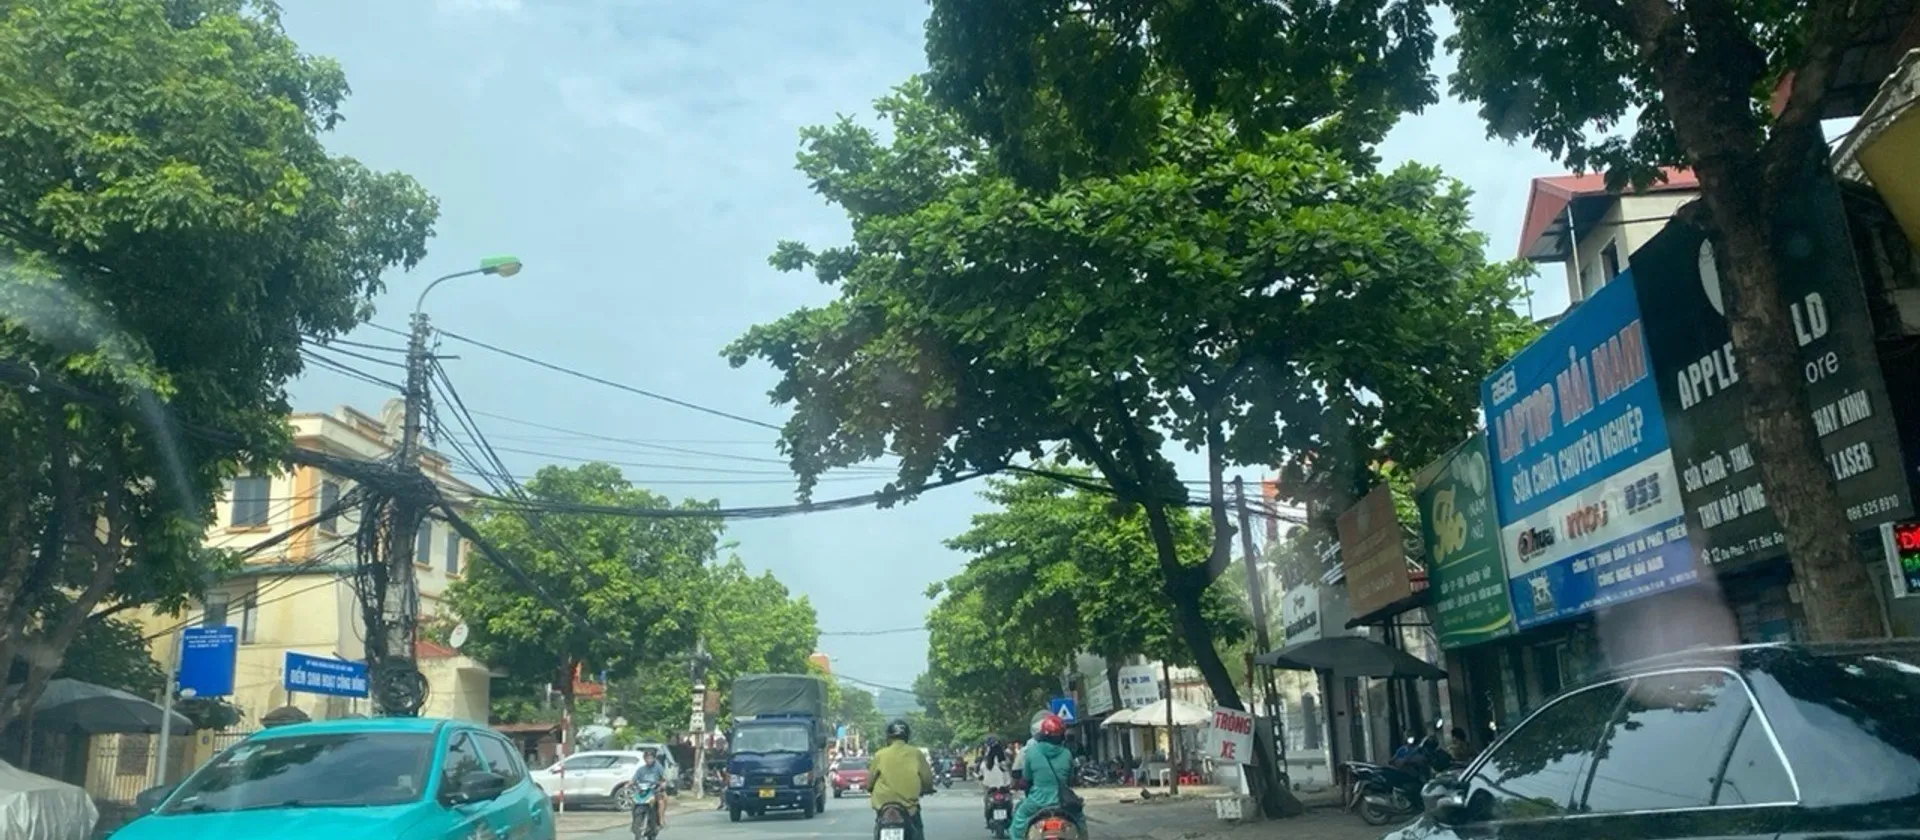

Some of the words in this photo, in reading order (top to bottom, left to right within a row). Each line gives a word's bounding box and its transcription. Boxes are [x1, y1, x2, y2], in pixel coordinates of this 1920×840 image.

[1496, 382, 1556, 464] LAPTOP
[1556, 345, 1594, 427] HẢI
[1591, 318, 1648, 405] NAM
[1676, 341, 1739, 410] APPLE
[1837, 388, 1872, 427] KÍNH
[1532, 453, 1560, 494] CHỮA
[1558, 429, 1601, 482] CHUYÊN
[1600, 403, 1644, 460] NGHIỆP
[1831, 441, 1874, 481] LASER
[1220, 740, 1236, 760] XE
